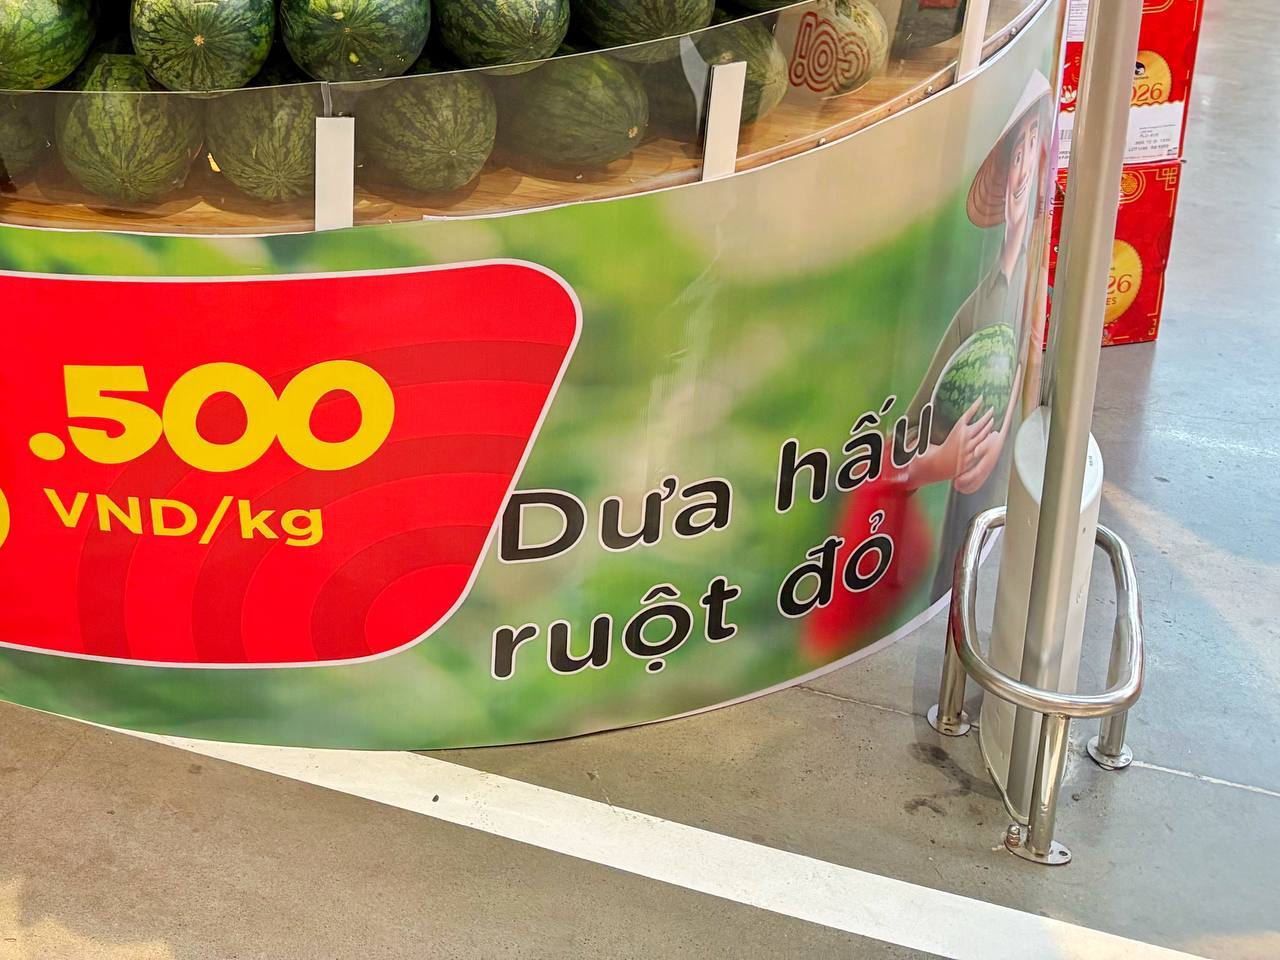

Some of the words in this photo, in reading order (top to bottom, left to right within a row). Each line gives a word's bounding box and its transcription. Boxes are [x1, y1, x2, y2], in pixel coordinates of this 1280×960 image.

[42, 488, 324, 548] VND/kg
[498, 476, 732, 564] Dưa
[775, 395, 933, 513] hấu
[491, 575, 741, 681] ruột
[777, 510, 894, 618] đỏ
